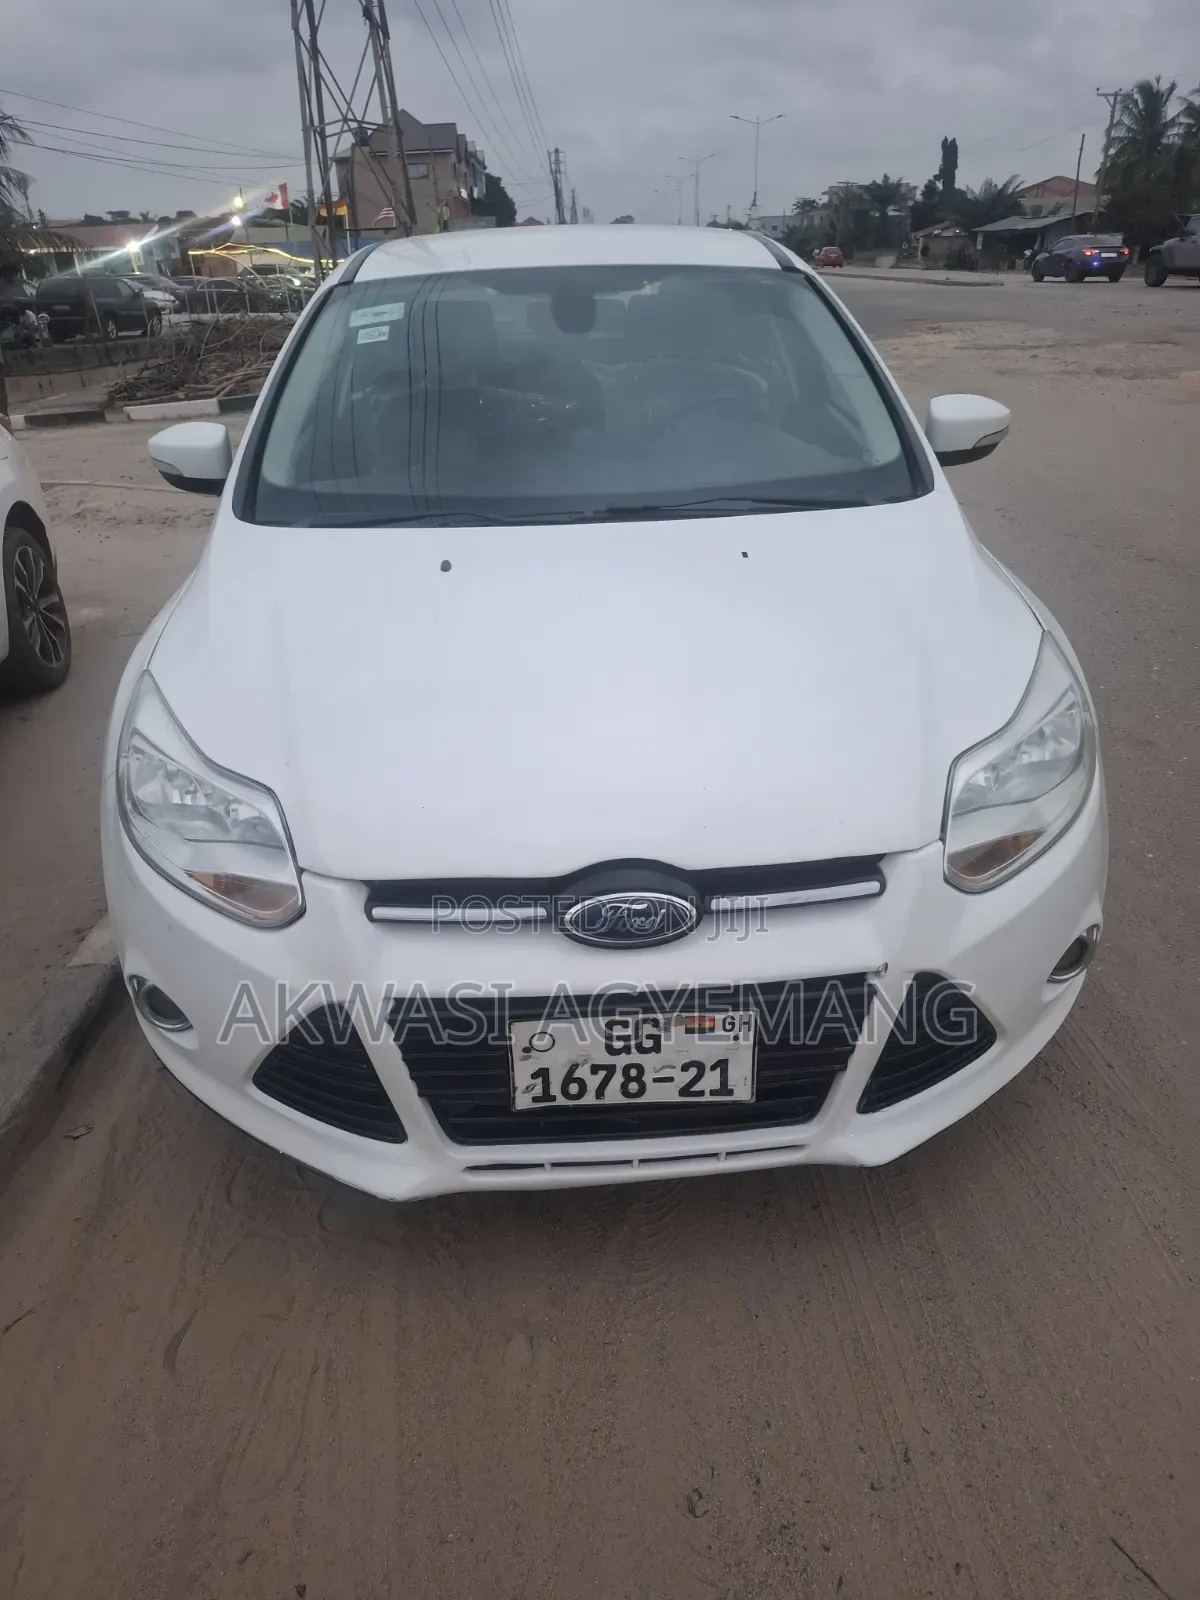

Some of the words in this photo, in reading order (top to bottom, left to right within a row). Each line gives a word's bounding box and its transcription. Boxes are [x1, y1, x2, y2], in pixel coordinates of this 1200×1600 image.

[597, 902, 666, 932] Ford
[604, 1017, 662, 1057] GG
[721, 1013, 753, 1034] GH
[529, 1058, 735, 1103] 1678-21
